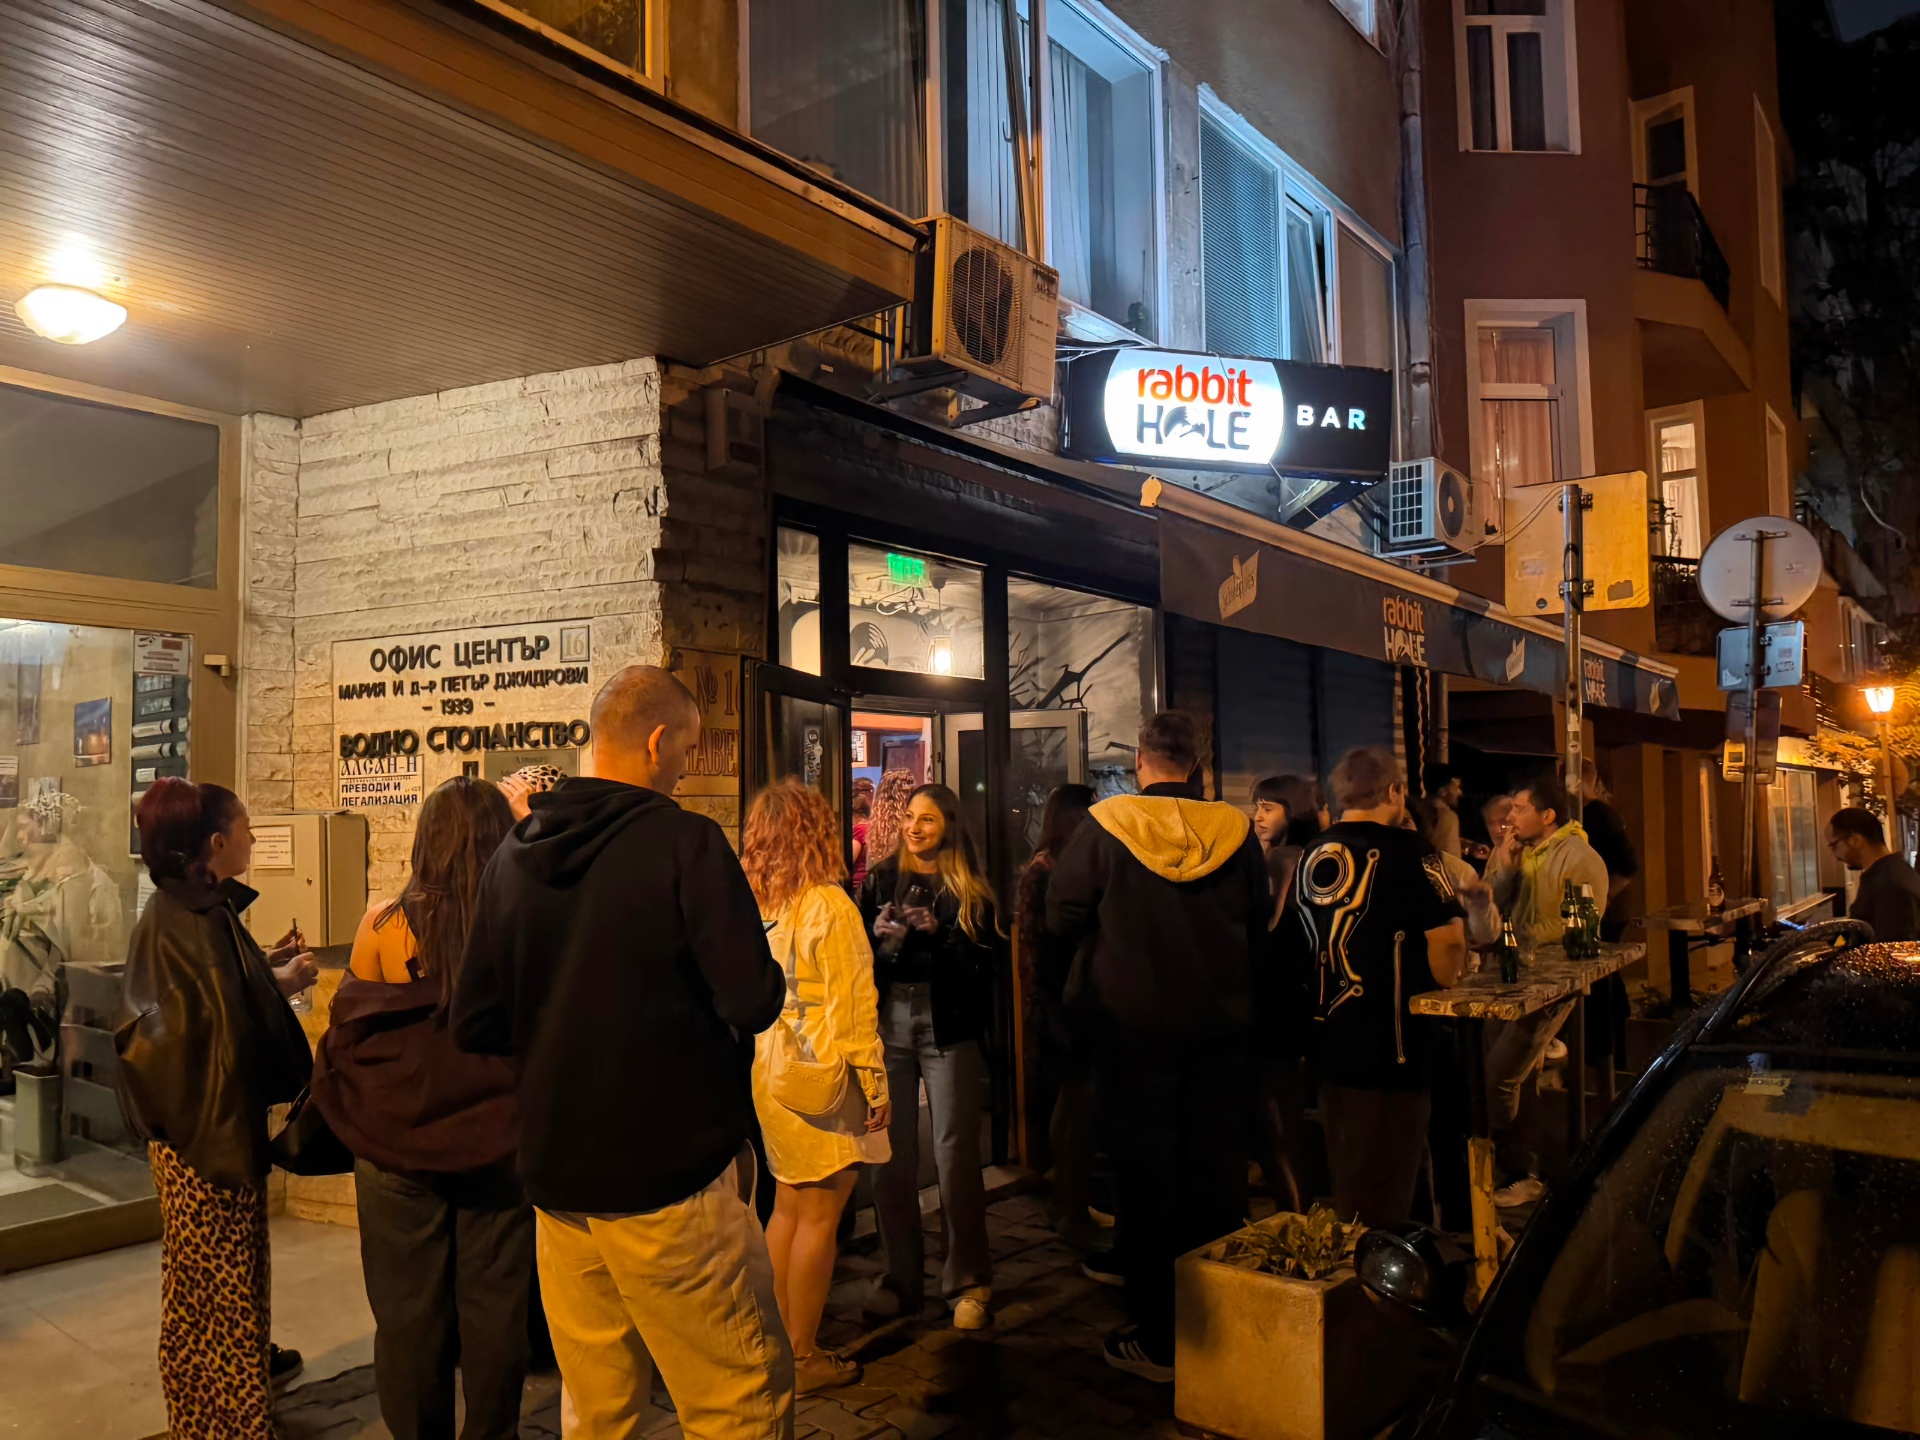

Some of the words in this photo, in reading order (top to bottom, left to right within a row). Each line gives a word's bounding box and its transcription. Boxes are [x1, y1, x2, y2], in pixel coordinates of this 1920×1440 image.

[1138, 364, 1253, 407] rabbit
[1297, 405, 1366, 430] BAR
[1383, 594, 1425, 634] rabbit
[370, 644, 441, 674] ОФИС
[454, 635, 550, 668] ЦЕНТЪР
[565, 632, 585, 656] 16
[339, 681, 386, 700] МАРИЯ
[392, 680, 404, 696] И
[441, 674, 490, 693] ПЕТЪР
[493, 667, 589, 691] ДЖИДРОВИ
[724, 669, 740, 716] 1
[441, 698, 474, 715] 1939
[340, 729, 419, 757] ВОДНО
[426, 719, 591, 752] СТОПАНСТВО
[341, 783, 390, 793] ПРЕВОДИ
[393, 782, 401, 791] И
[341, 794, 418, 807] ЛЕГАЛИЗАЦИЯ
